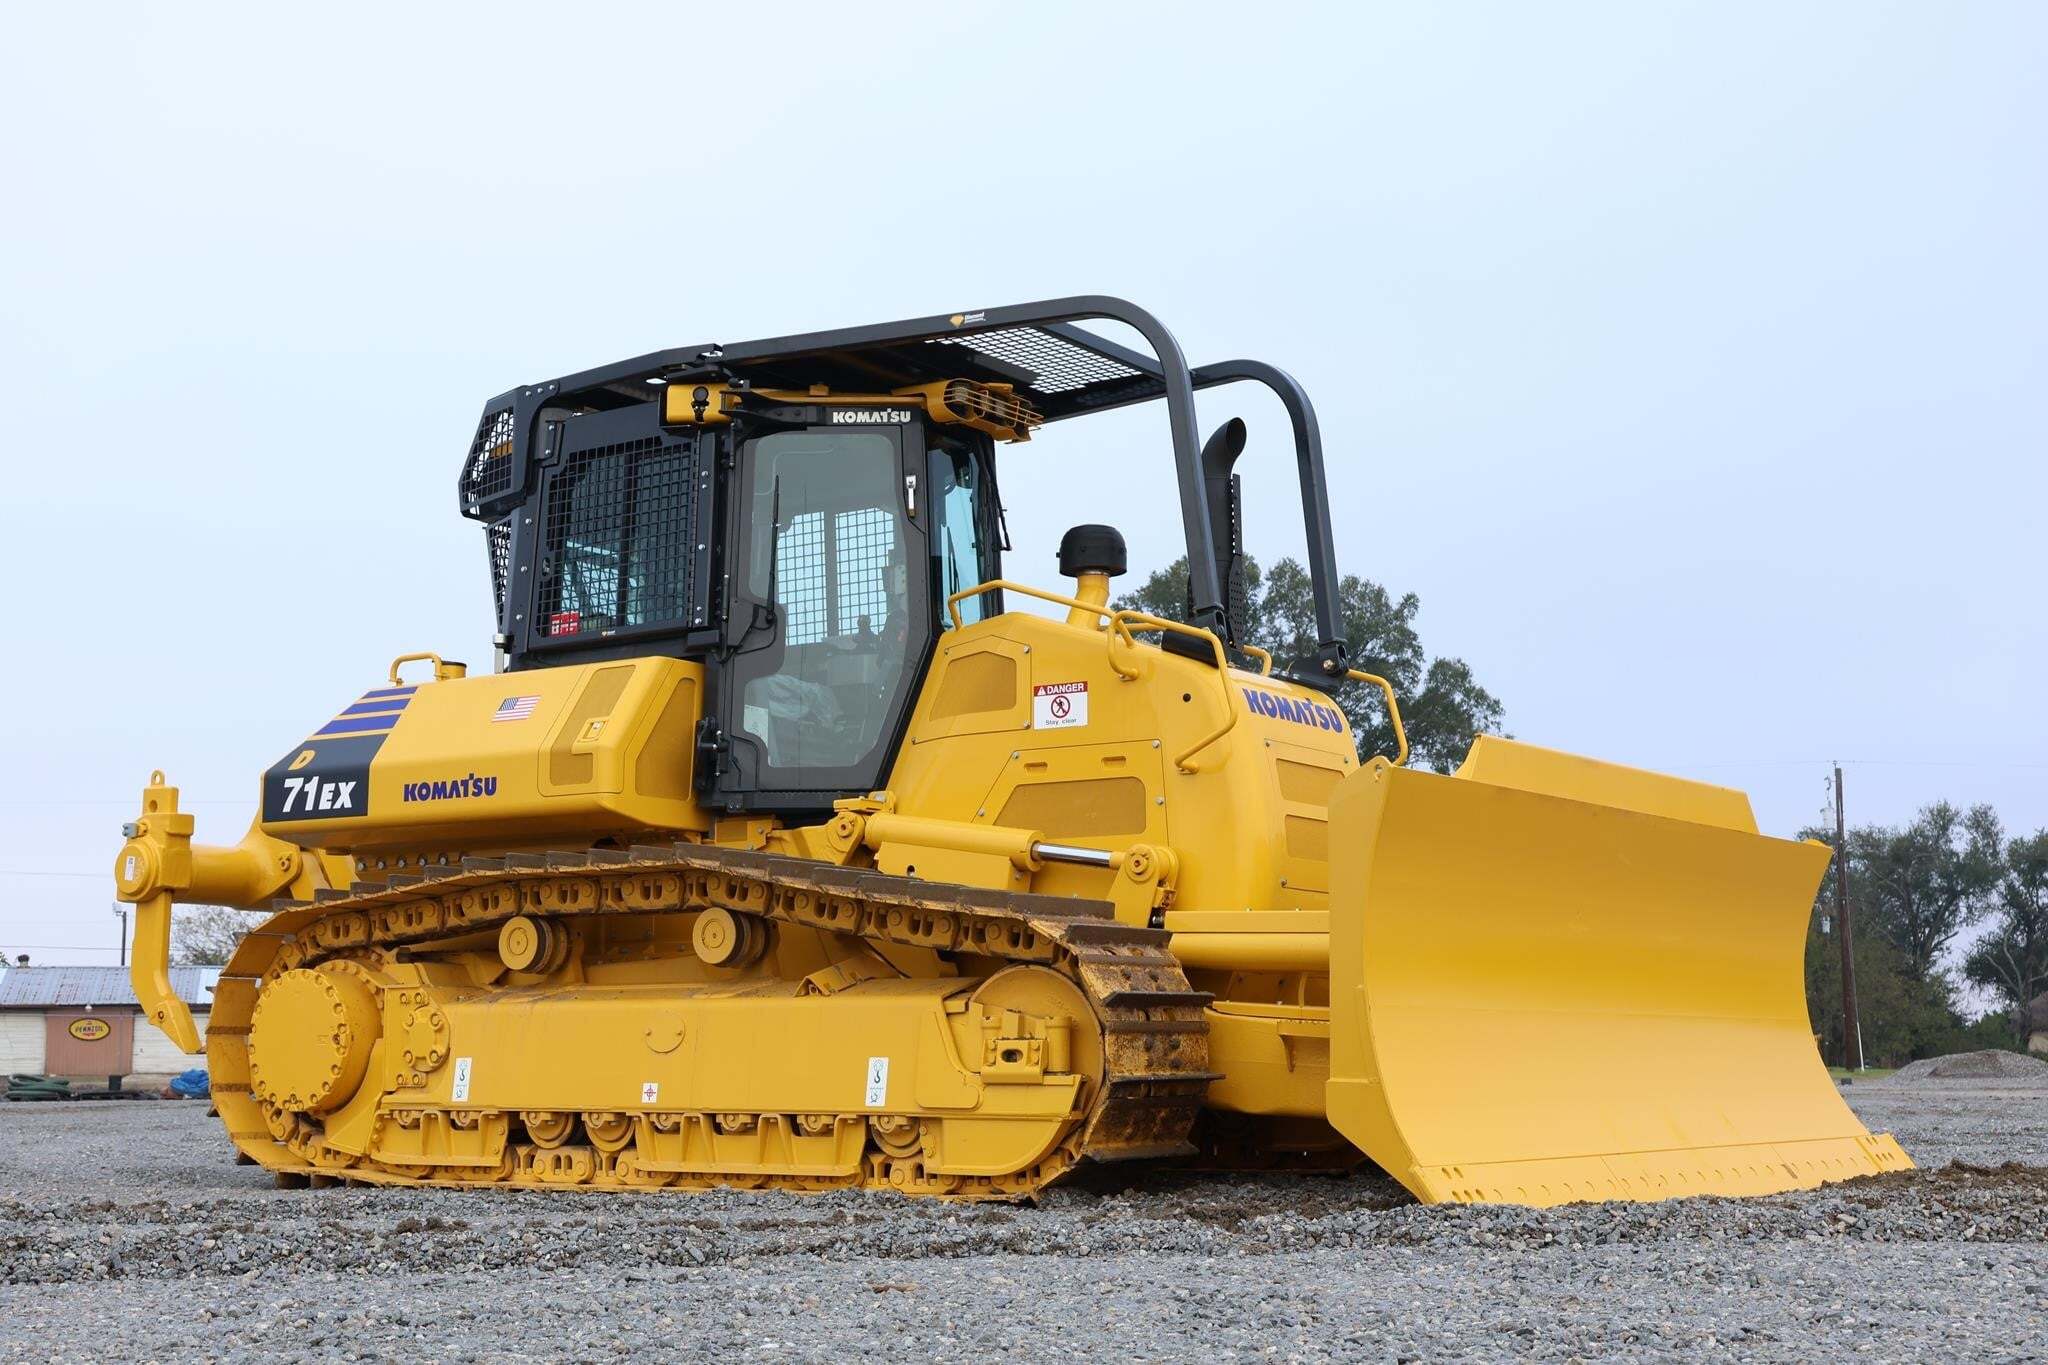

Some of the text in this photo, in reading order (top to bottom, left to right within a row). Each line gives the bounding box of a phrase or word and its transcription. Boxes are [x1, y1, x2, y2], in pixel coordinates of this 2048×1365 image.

[832, 408, 911, 423] KOMATSU
[1047, 683, 1085, 694] DANGER
[1242, 687, 1343, 733] KOMATSU
[288, 750, 315, 771] D
[403, 773, 497, 802] KOMATSU
